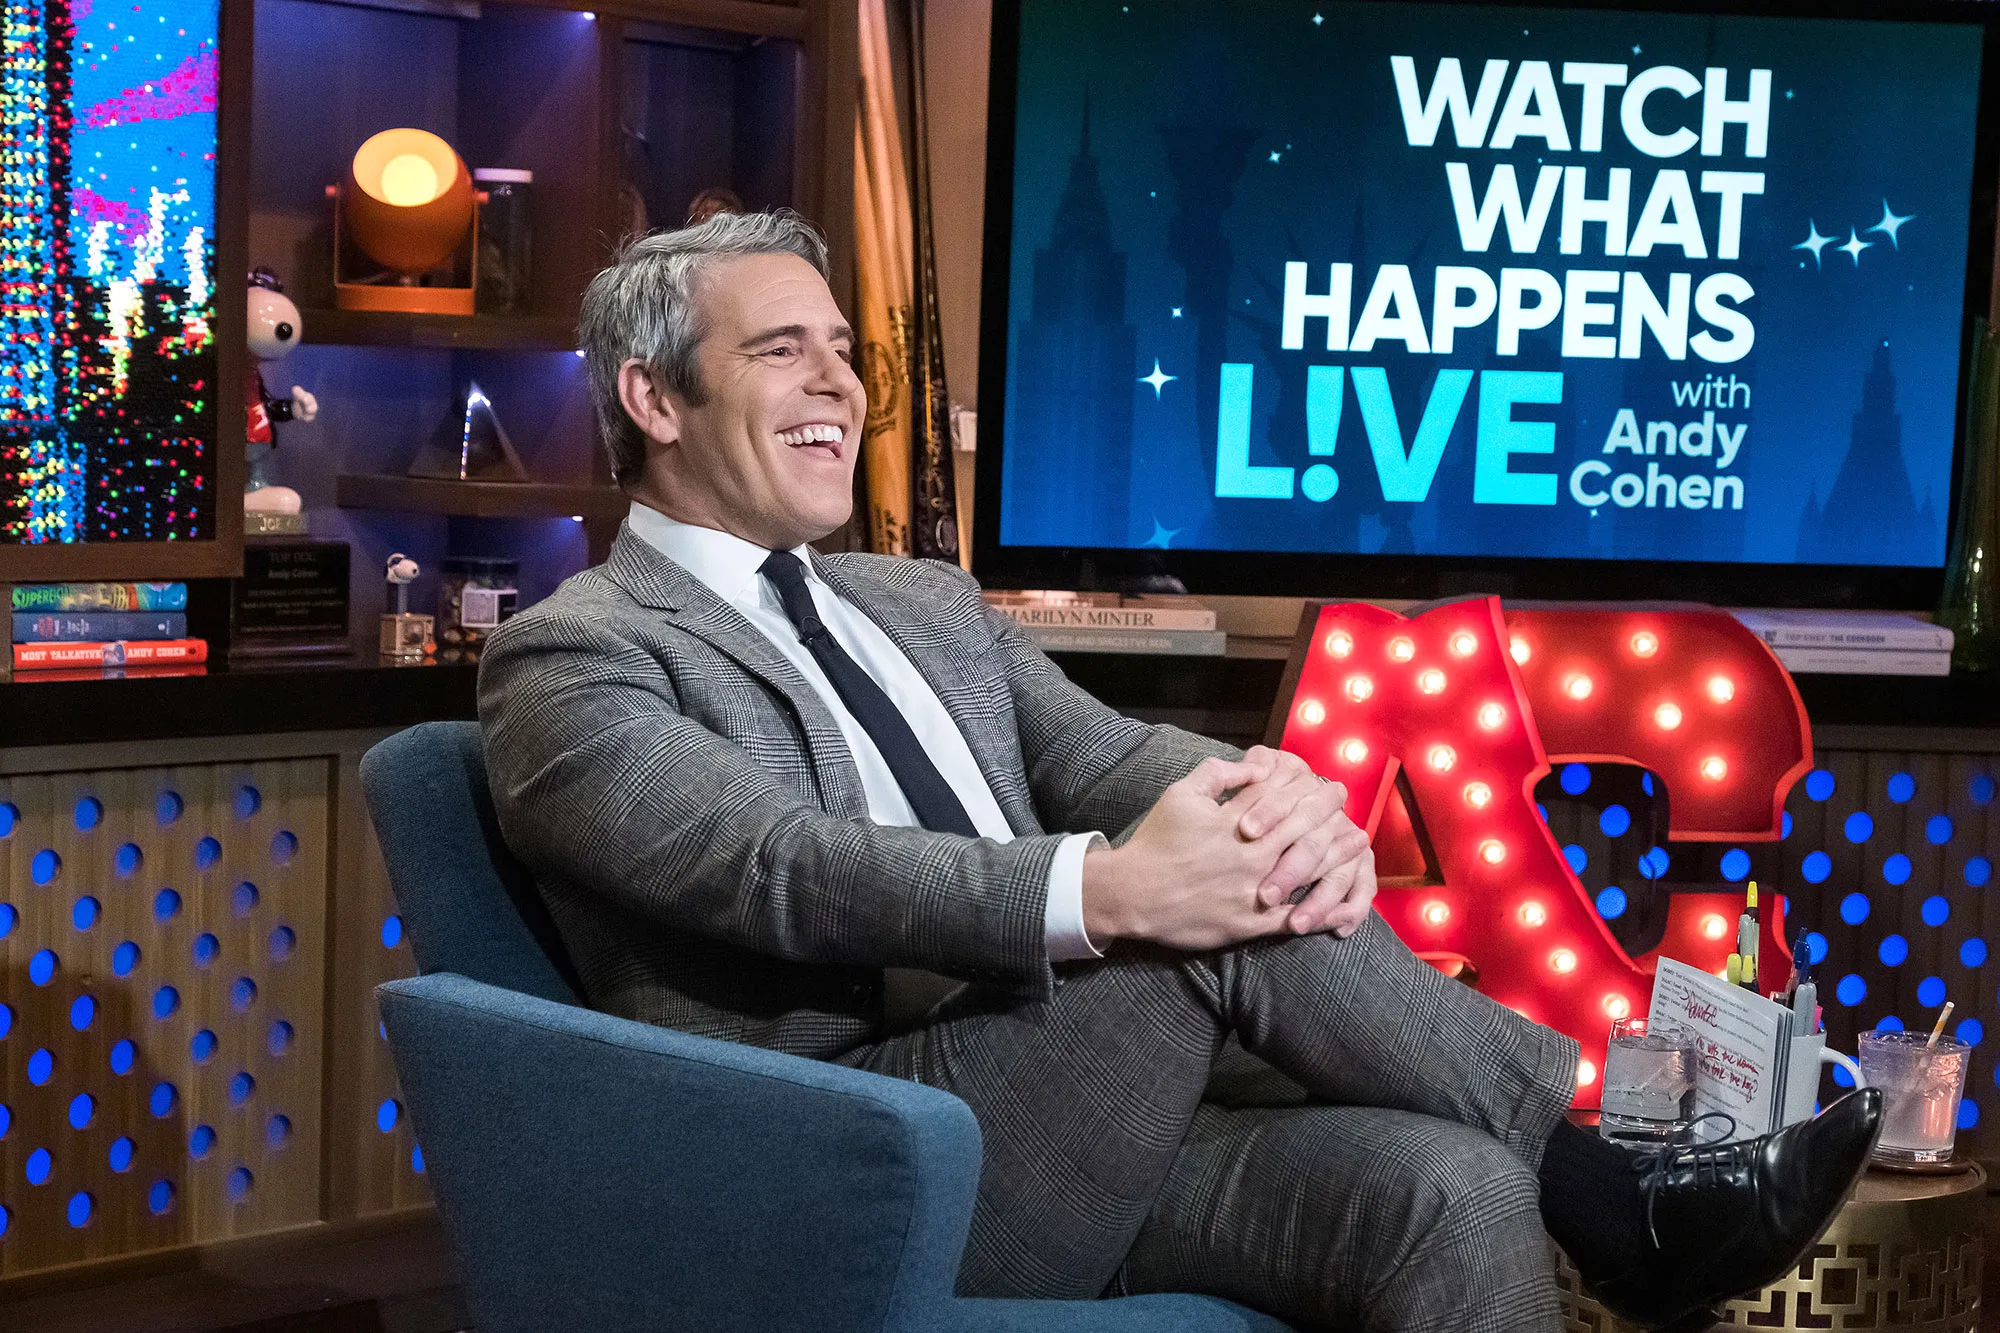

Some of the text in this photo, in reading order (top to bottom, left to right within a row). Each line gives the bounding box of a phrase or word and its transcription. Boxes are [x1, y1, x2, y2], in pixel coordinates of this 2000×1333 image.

[1391, 55, 1772, 158] WATCH
[1446, 162, 1766, 260] WHAT
[1281, 261, 1756, 363] HAPPENS
[1671, 374, 1751, 408] with
[1215, 363, 1564, 505] L!VE
[1602, 408, 1748, 469] Andy
[1569, 459, 1744, 510] Cohen
[1003, 608, 1155, 627] MARILYN MINTER
[21, 647, 186, 661] MOST TALKATIVE ANDY COHEN
